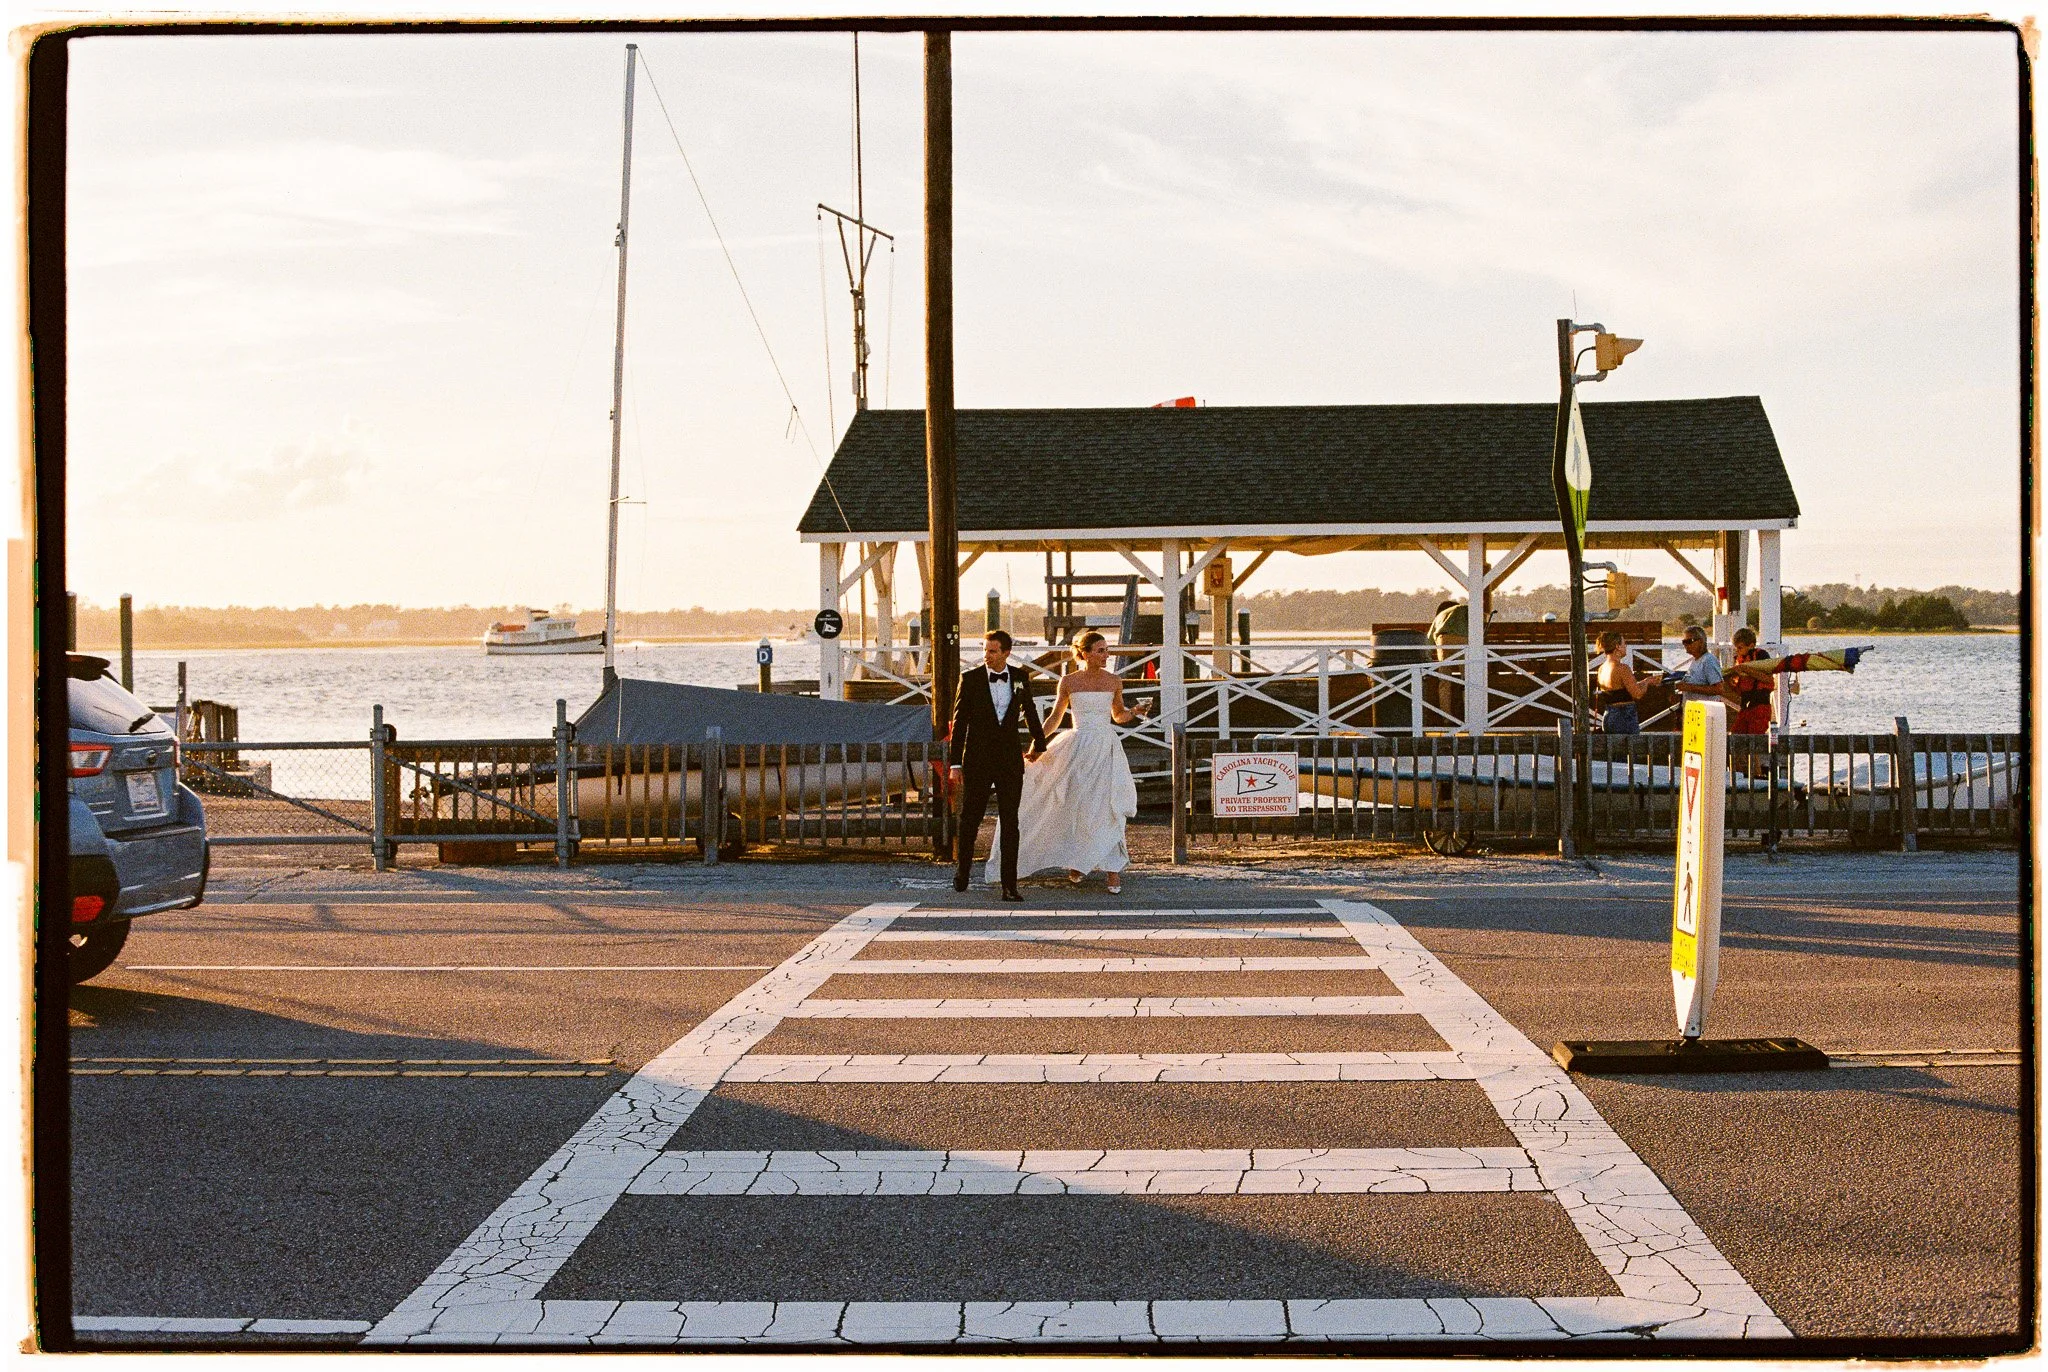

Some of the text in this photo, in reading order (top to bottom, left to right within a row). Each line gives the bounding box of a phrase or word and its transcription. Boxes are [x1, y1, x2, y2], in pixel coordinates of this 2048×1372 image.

[759, 651, 769, 662] D
[1216, 757, 1296, 781] CAROLINA YACHT CLUB
[1253, 796, 1292, 804] PROPERTY
